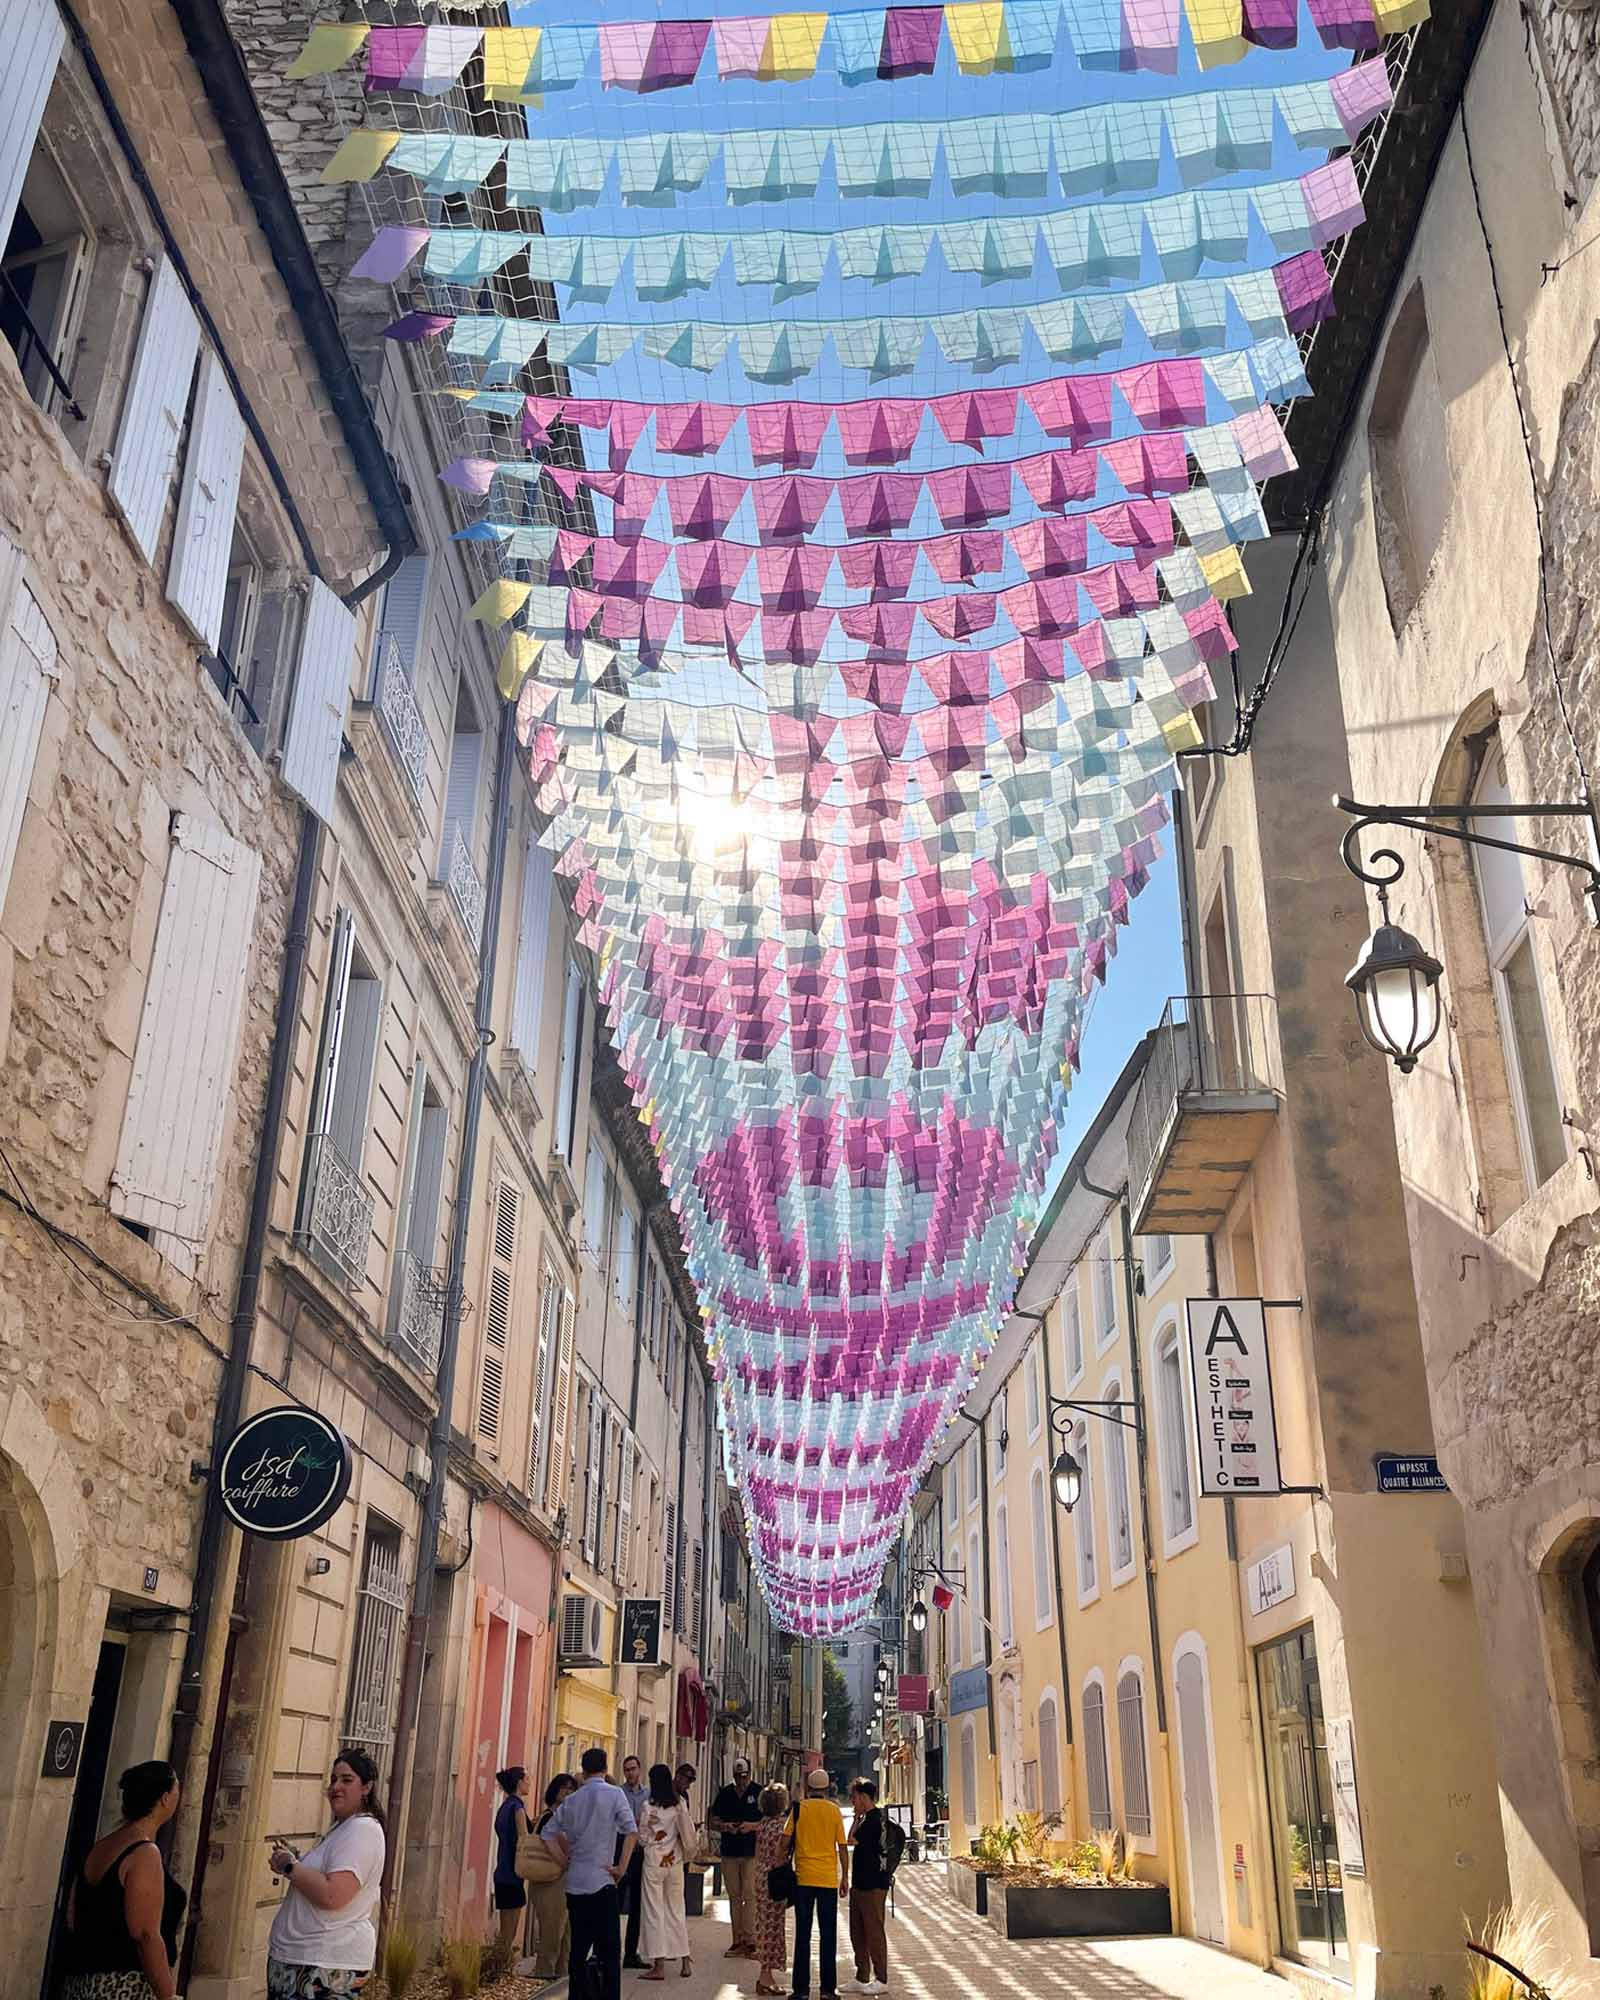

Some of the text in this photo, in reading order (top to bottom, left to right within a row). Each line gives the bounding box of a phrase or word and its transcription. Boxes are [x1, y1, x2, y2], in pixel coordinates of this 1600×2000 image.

[1396, 1463, 1429, 1473] IMPASSE
[1383, 1476, 1446, 1488] QUATRE ALLIANCES
[222, 1477, 300, 1508] coiffure
